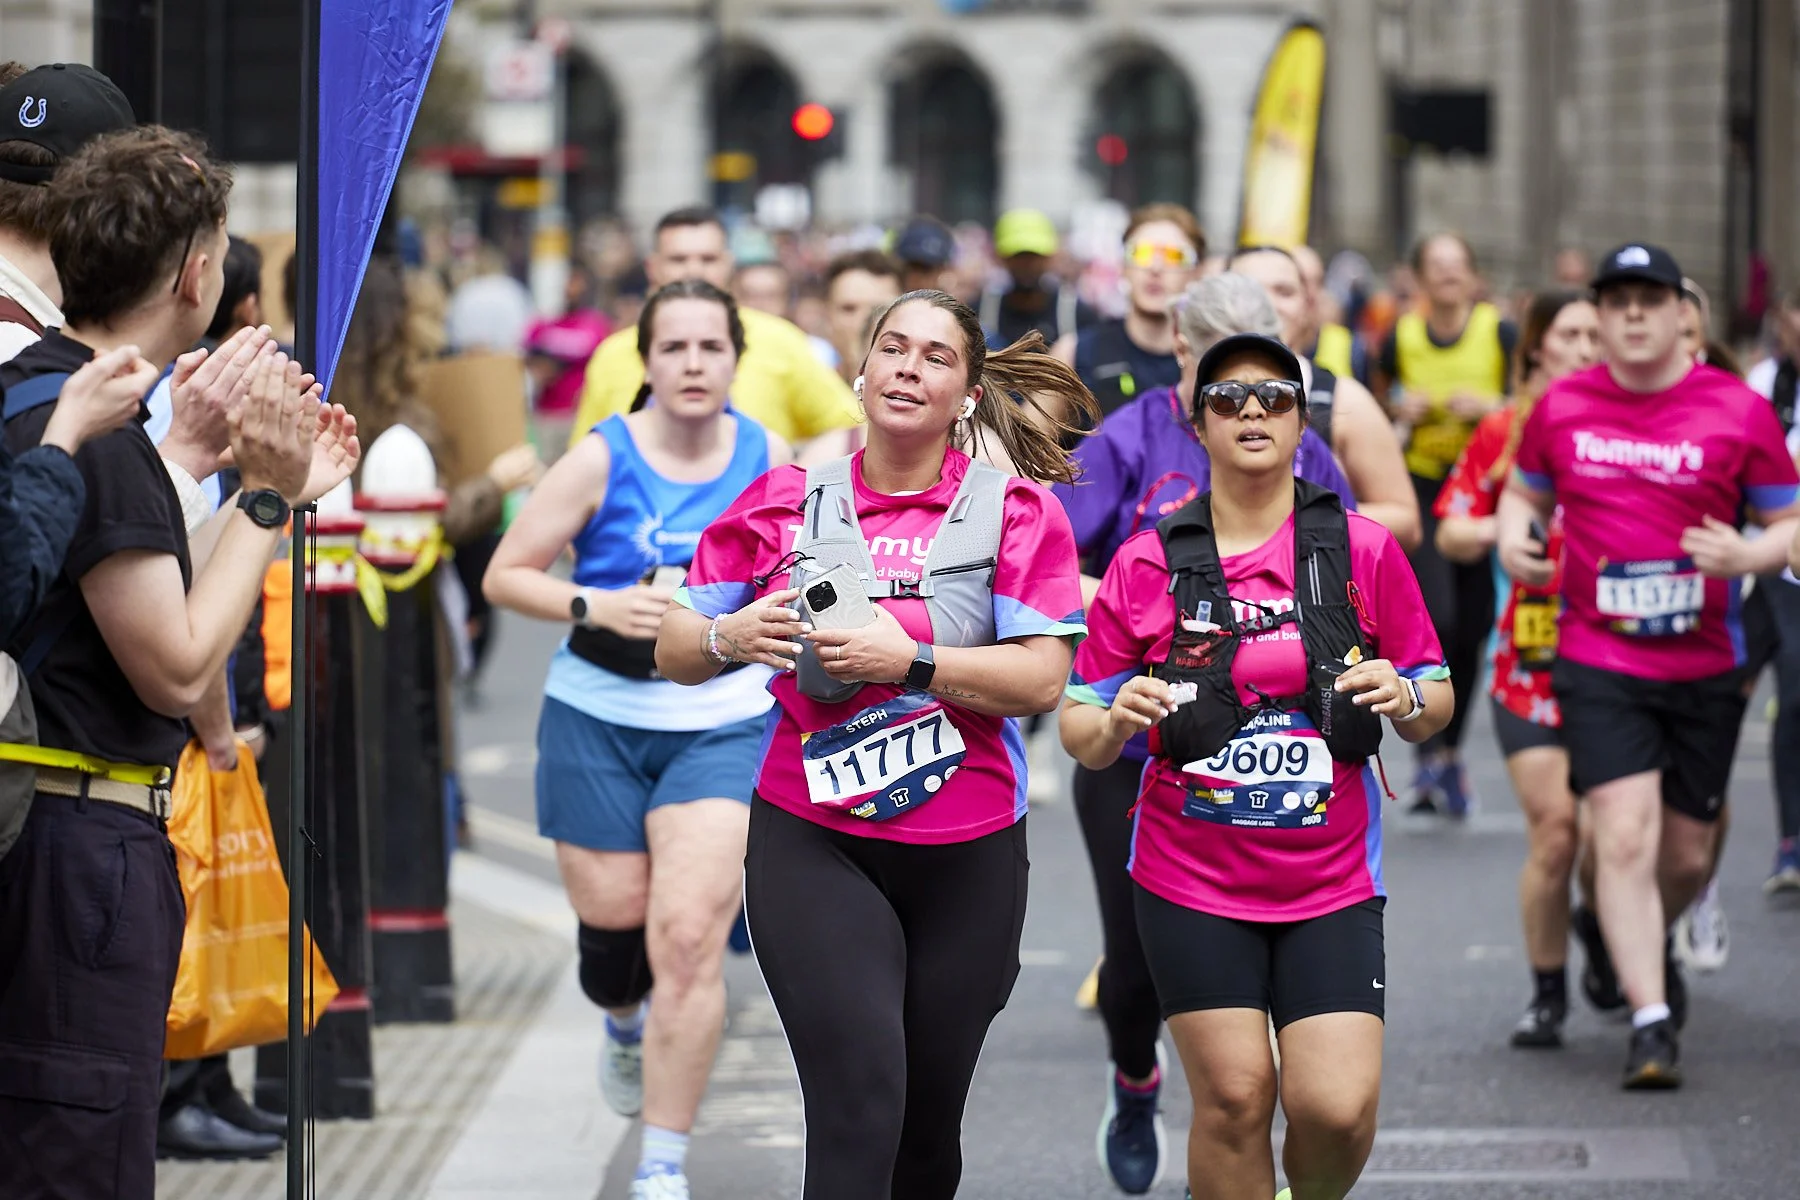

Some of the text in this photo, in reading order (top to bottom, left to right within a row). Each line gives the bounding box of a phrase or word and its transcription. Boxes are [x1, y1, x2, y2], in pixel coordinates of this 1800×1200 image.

[1572, 431, 1704, 474] Tommy's
[887, 566, 920, 581] baby
[1256, 630, 1280, 643] and
[845, 708, 888, 733] STEPH
[819, 714, 943, 795] 11777
[1206, 741, 1309, 776] 9609
